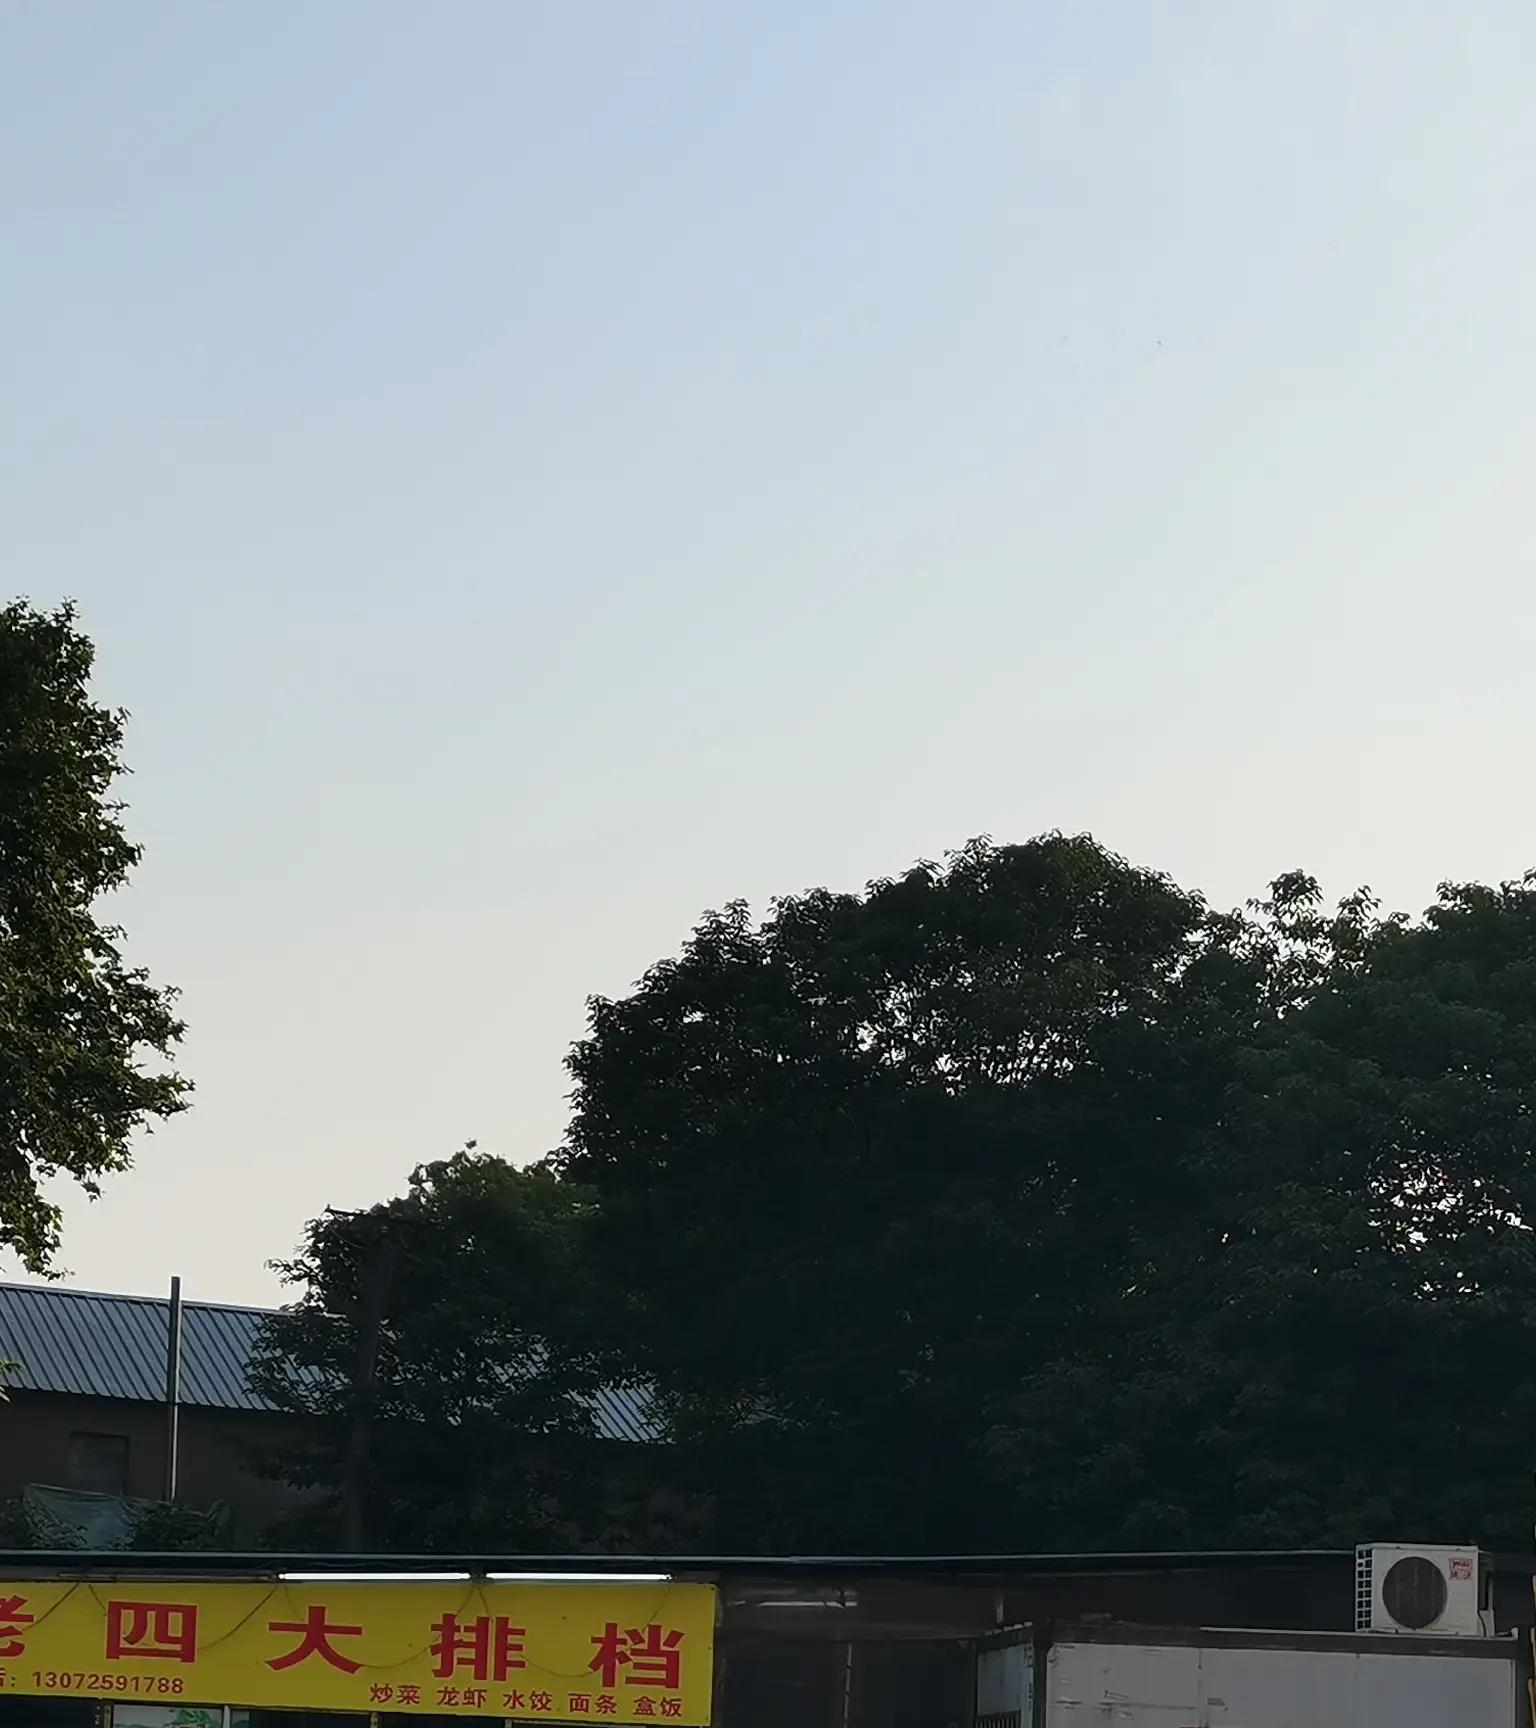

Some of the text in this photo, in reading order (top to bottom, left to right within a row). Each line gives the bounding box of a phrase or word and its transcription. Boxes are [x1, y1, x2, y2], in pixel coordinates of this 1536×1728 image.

[369, 1682, 683, 1718] 炒菜 龙虾 水饺 面条 盒饭
